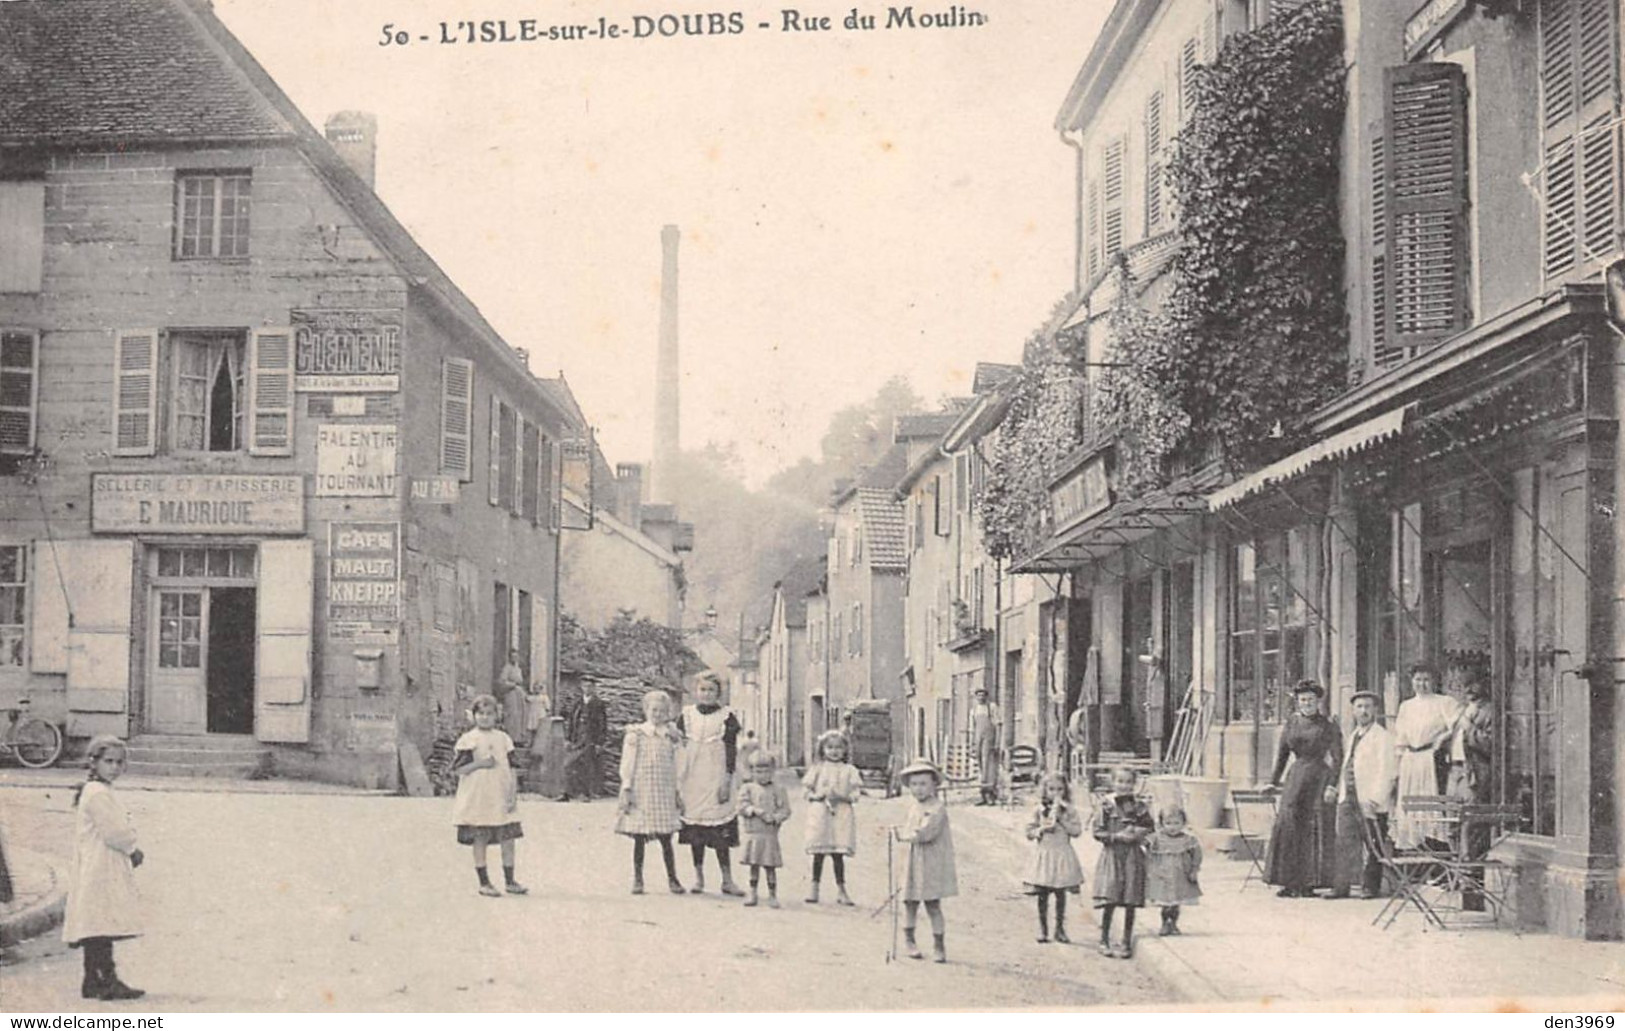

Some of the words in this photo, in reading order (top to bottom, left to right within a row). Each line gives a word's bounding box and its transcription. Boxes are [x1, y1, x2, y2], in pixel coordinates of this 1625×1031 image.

[320, 431, 396, 449] RALENTIR
[347, 453, 367, 468] AU
[98, 479, 164, 492] SELLERIE
[177, 479, 194, 492] ET
[206, 479, 296, 492] TAPISSERIE
[318, 475, 395, 491] TOURNANT
[411, 480, 429, 498] AU
[337, 559, 392, 575] MALT
[331, 582, 396, 602] KNEIPP
